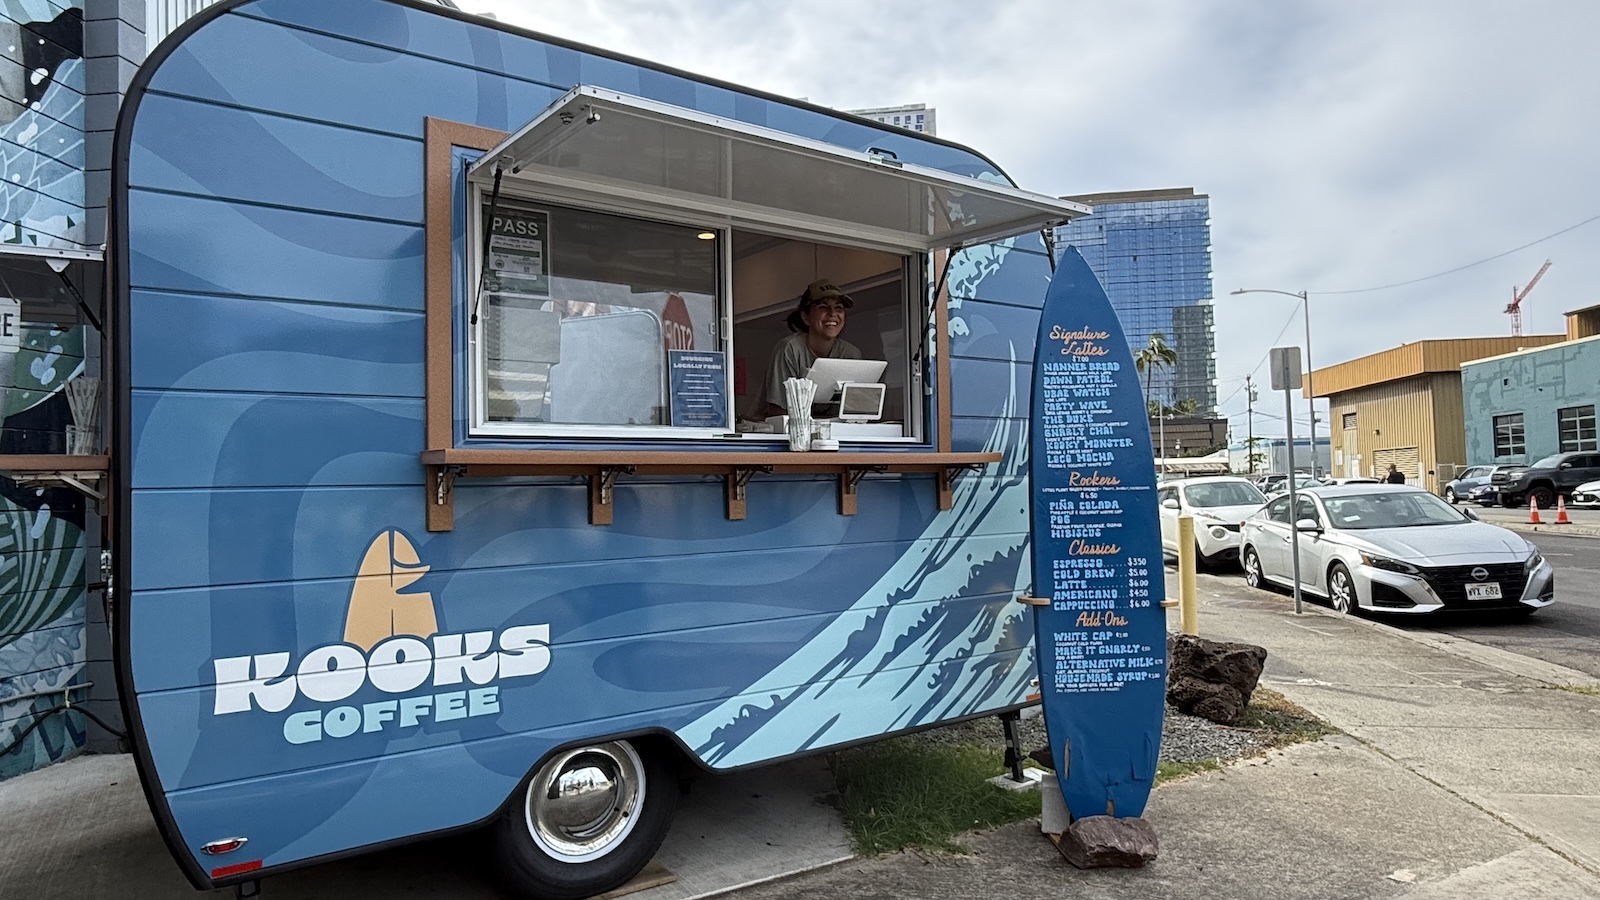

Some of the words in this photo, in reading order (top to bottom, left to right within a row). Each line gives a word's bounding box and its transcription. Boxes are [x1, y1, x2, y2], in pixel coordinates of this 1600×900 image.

[492, 217, 539, 236] PASS
[1049, 325, 1110, 344] Signature
[1061, 341, 1110, 356] Lattes
[1043, 362, 1087, 372] NANNER
[1089, 362, 1120, 371] BREAD
[1043, 376, 1073, 385] DAWN
[1076, 374, 1113, 384] PATROL
[1044, 389, 1070, 398] UBAE
[1072, 388, 1110, 397] WATCH
[1044, 402, 1075, 411] PARTY
[1079, 400, 1108, 410] WAVE
[1042, 415, 1064, 424] THE
[1066, 414, 1094, 424] DUKE
[1044, 427, 1085, 437] GNARLY
[1089, 426, 1114, 436] CHAI
[1045, 441, 1080, 450] KOOKY
[1084, 438, 1134, 449] MONSTER
[1047, 454, 1072, 464] LOCO
[1076, 452, 1115, 462] MOCHA
[1069, 470, 1120, 486] Rockers
[1049, 499, 1074, 511] PIÑA
[1079, 500, 1120, 510] COLADA
[1050, 515, 1071, 525] POG
[1051, 528, 1102, 539] HIBISCUS
[1068, 539, 1121, 556] Classics
[1053, 559, 1103, 569] ESPRESSO
[1053, 569, 1080, 579] COLD
[1084, 568, 1115, 578] BREW
[1128, 568, 1148, 577] $5.00
[1054, 580, 1088, 590] LATTE
[1128, 578, 1149, 588] $6.00
[1053, 589, 1118, 600] AMERICANO
[1053, 600, 1115, 611] CAPPUCCINO
[1129, 599, 1150, 609] $6.00
[1075, 611, 1129, 627] Add-Ons
[1053, 632, 1088, 642] WHITE
[1092, 631, 1113, 641] CAP
[1055, 646, 1083, 656] MAKE
[1085, 646, 1097, 655] IT
[1098, 644, 1140, 654] GNARLY
[214, 623, 551, 716] KOOKS
[1055, 658, 1126, 670] ALTERNATIVE
[1127, 657, 1154, 668] MILK
[1055, 672, 1113, 684] HOUSEMADE
[1117, 671, 1148, 682] SYRUP
[283, 686, 500, 744] COFFEE
